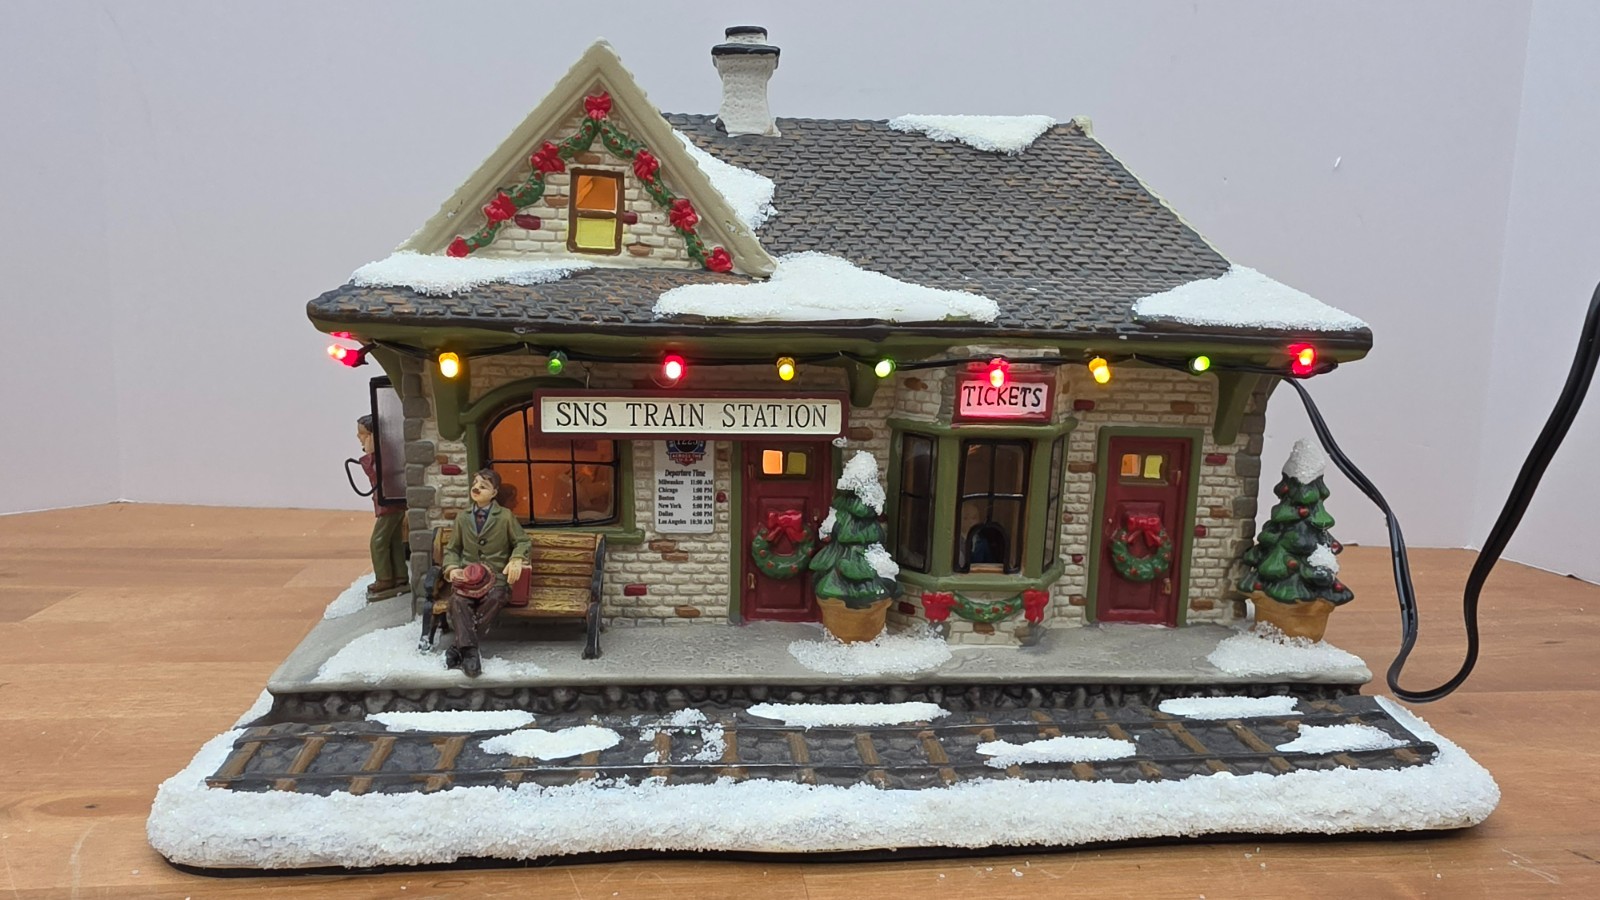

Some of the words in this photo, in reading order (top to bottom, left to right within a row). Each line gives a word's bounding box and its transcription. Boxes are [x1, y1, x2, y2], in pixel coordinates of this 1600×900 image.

[962, 385, 1043, 408] TICKETS
[555, 401, 608, 427] SNS
[625, 402, 705, 428] TRAIN
[721, 403, 828, 429] STATION
[664, 469, 691, 478] Departure
[692, 469, 706, 477] Time
